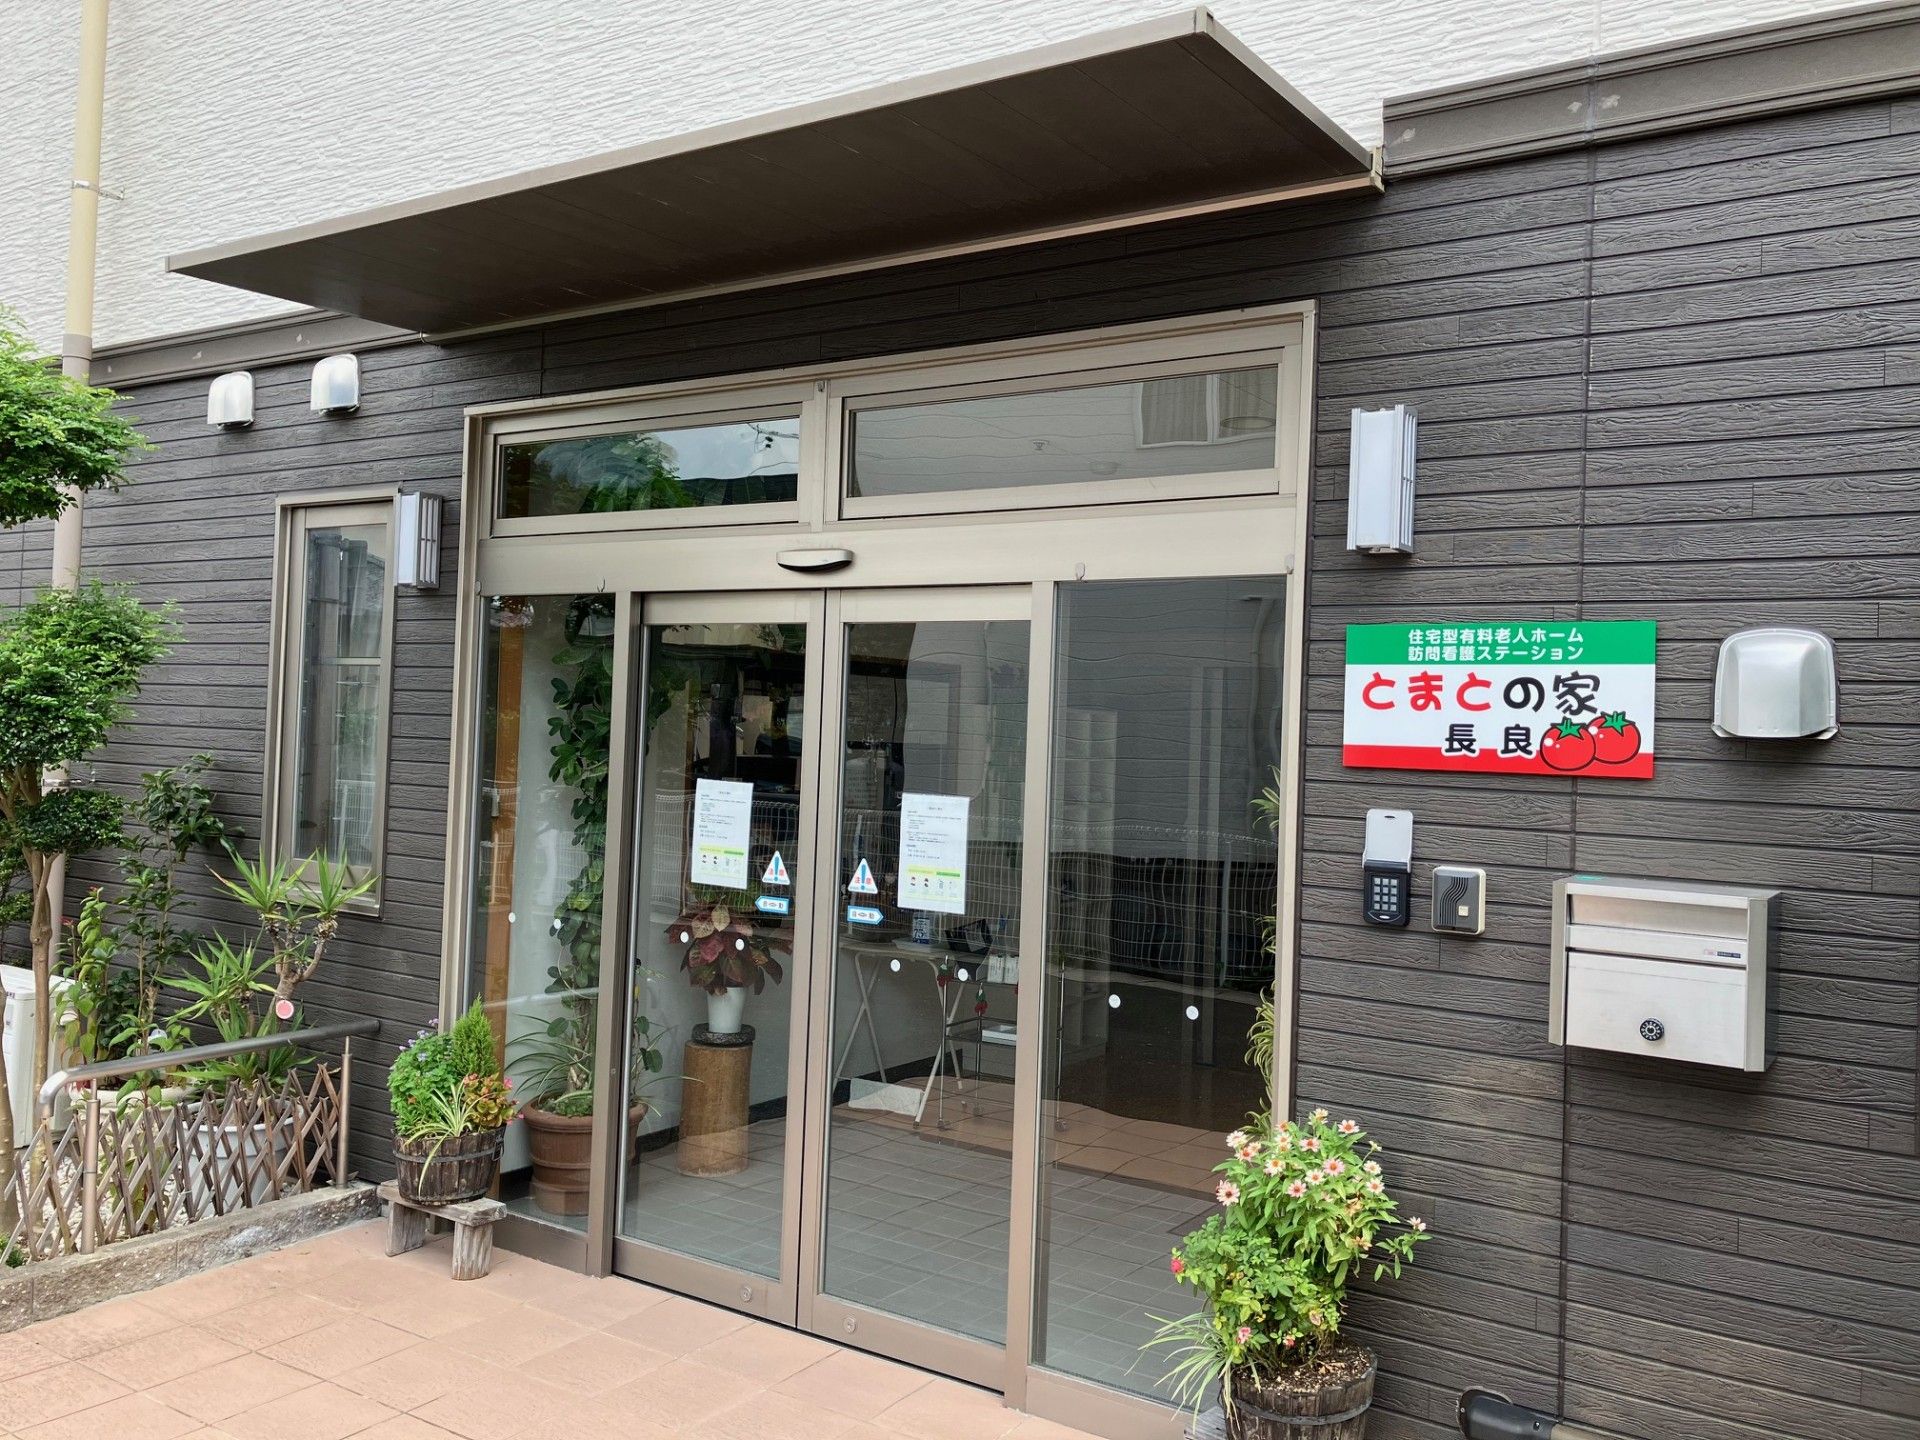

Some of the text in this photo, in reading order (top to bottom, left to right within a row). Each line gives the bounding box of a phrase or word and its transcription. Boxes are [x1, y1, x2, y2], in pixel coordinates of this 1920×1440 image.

[1408, 628, 1583, 644] 住宅型有料老人ホーム
[1408, 645, 1583, 661] 訪問看護ステーション
[1362, 671, 1600, 715] とまとの家
[1445, 723, 1532, 756] 長良
